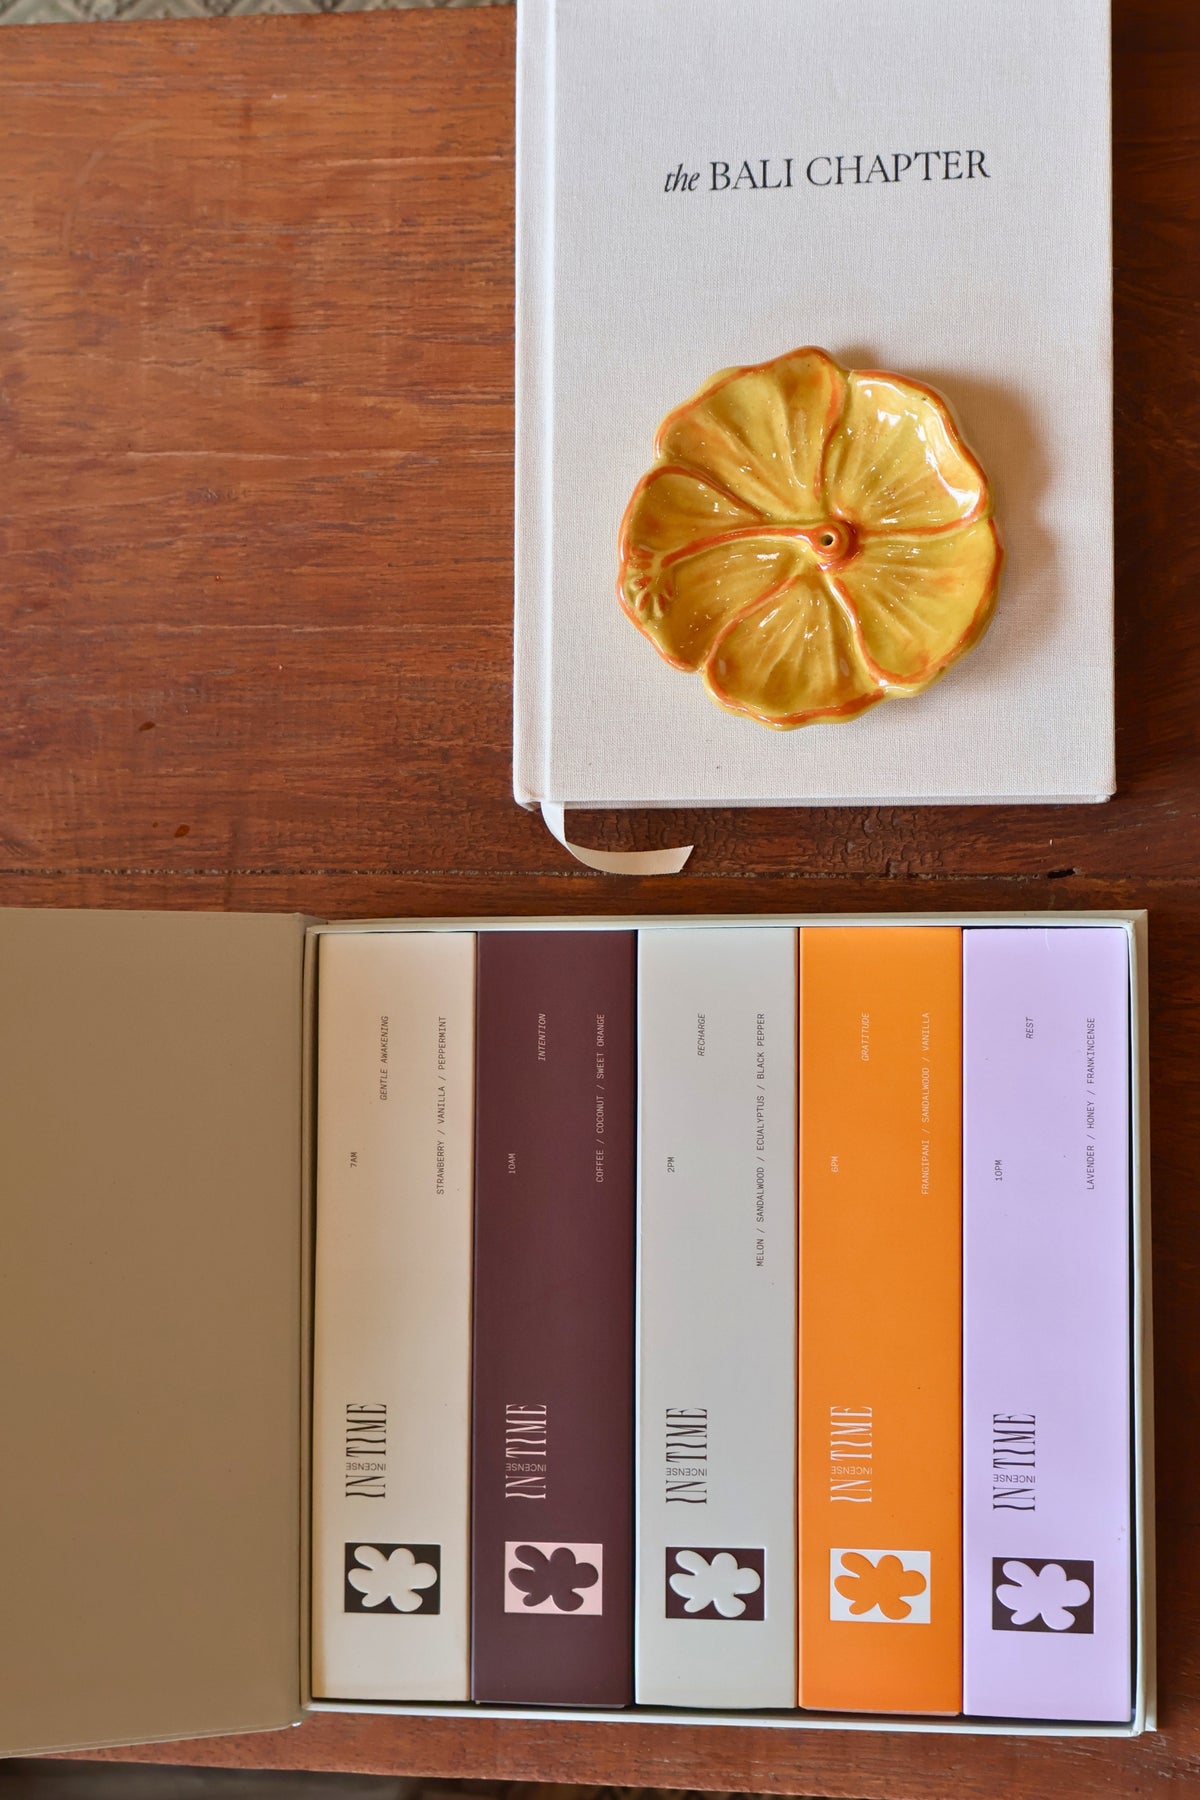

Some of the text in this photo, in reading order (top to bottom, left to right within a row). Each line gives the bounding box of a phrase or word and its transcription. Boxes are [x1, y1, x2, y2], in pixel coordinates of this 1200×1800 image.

[664, 149, 991, 193] the BALI CHAPTER
[438, 1016, 446, 1070] PEPPERMINT
[538, 1013, 546, 1061] INTENTION
[596, 1014, 605, 1047] ORANGE
[697, 1014, 705, 1056] RECHARGE
[757, 1014, 765, 1046] PEPPER
[861, 1012, 869, 1061] GRATITUDE
[921, 1013, 930, 1051] VANILLA
[1026, 1017, 1034, 1039] REST
[380, 1016, 388, 1101] GENTLE AWAKENING
[596, 1052, 604, 1079] SWEET
[1087, 1018, 1095, 1084] FRANKINCENSE
[437, 1086, 445, 1124] VANILLA
[596, 1096, 604, 1133] COCONUT
[921, 1067, 930, 1123] SANDALWOOD
[1087, 1101, 1095, 1129] HONEY
[756, 1096, 764, 1150] ECUALYPTUS
[436, 1141, 445, 1195] STRAWBERRY
[508, 1153, 516, 1174] 10AM
[596, 1149, 604, 1182] COFFEE
[667, 1157, 675, 1173] 2PM
[831, 1156, 839, 1173] 6PM
[921, 1140, 929, 1195] FRANGIPANI
[1087, 1145, 1095, 1190] LAVENDER
[756, 1167, 764, 1222] SANDALWOOD
[756, 1239, 764, 1266] MELON
[345, 1403, 387, 1498] IN TIME
[345, 1462, 386, 1471] INCENSE
[505, 1404, 547, 1499] IN TIME
[505, 1463, 547, 1472] INCENSE
[666, 1408, 708, 1504] IN TIME
[830, 1406, 873, 1503] IN TIME
[831, 1465, 873, 1474] INCENSE
[992, 1413, 1036, 1511] IN TIME
[666, 1467, 707, 1476] INCENSE
[993, 1474, 1036, 1483] INCENSE
